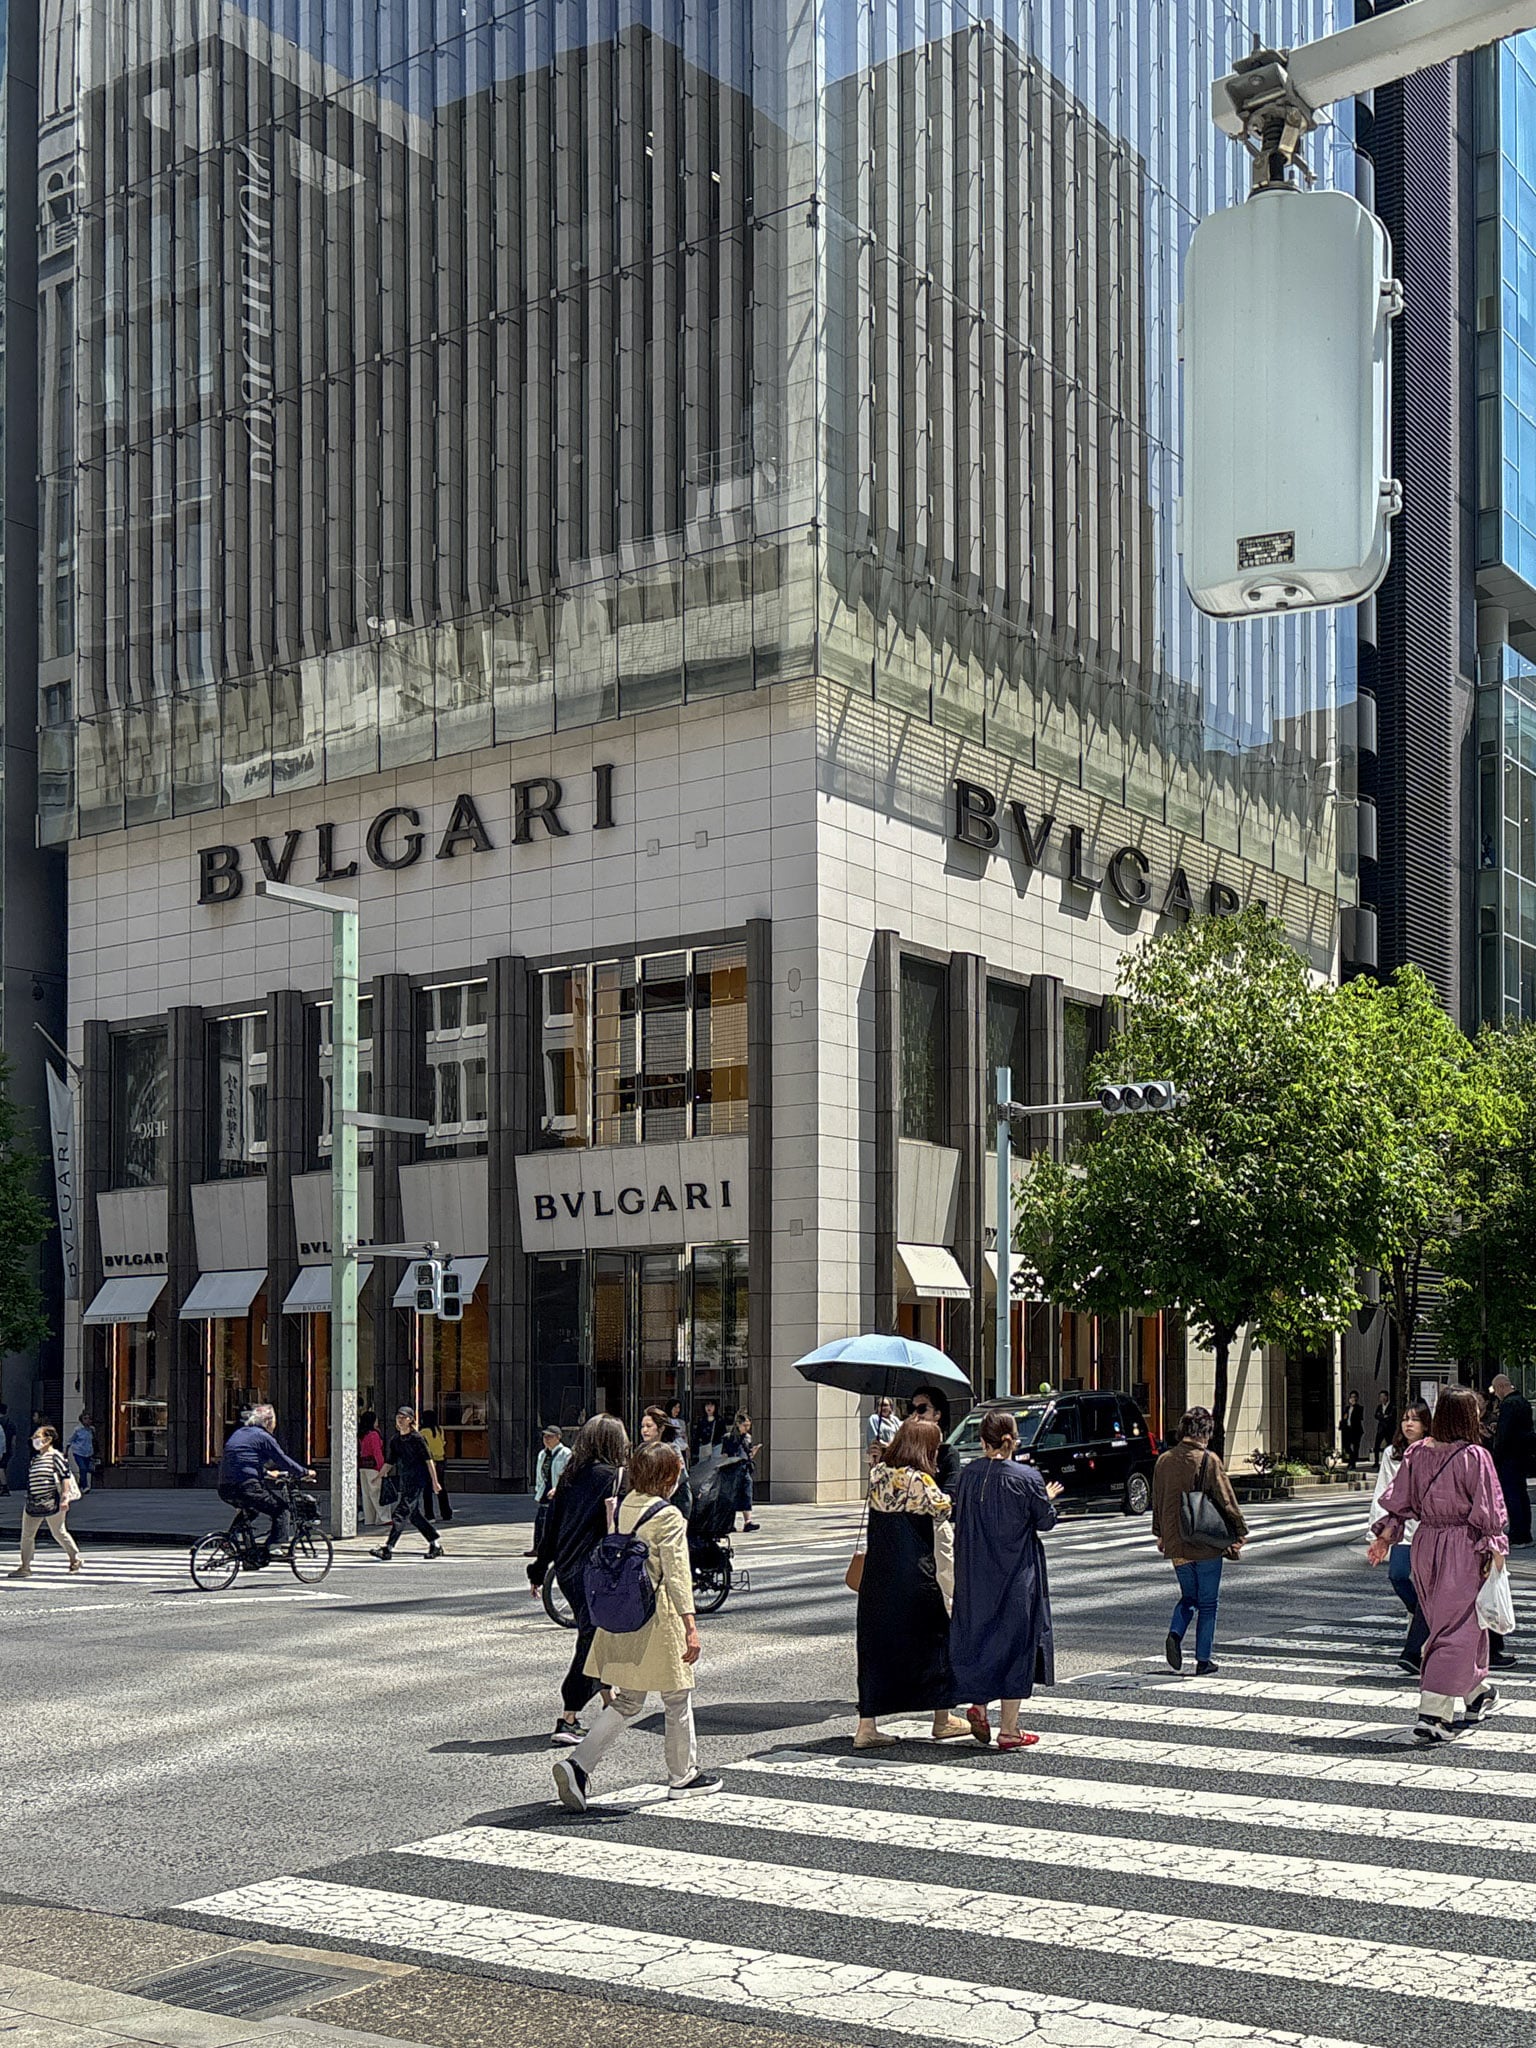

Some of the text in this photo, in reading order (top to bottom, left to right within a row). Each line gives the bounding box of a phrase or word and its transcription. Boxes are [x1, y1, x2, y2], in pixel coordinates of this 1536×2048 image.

[197, 762, 617, 905] BVLGARI
[953, 778, 1268, 922] BVLGAR
[534, 1180, 733, 1221] BVLGARI
